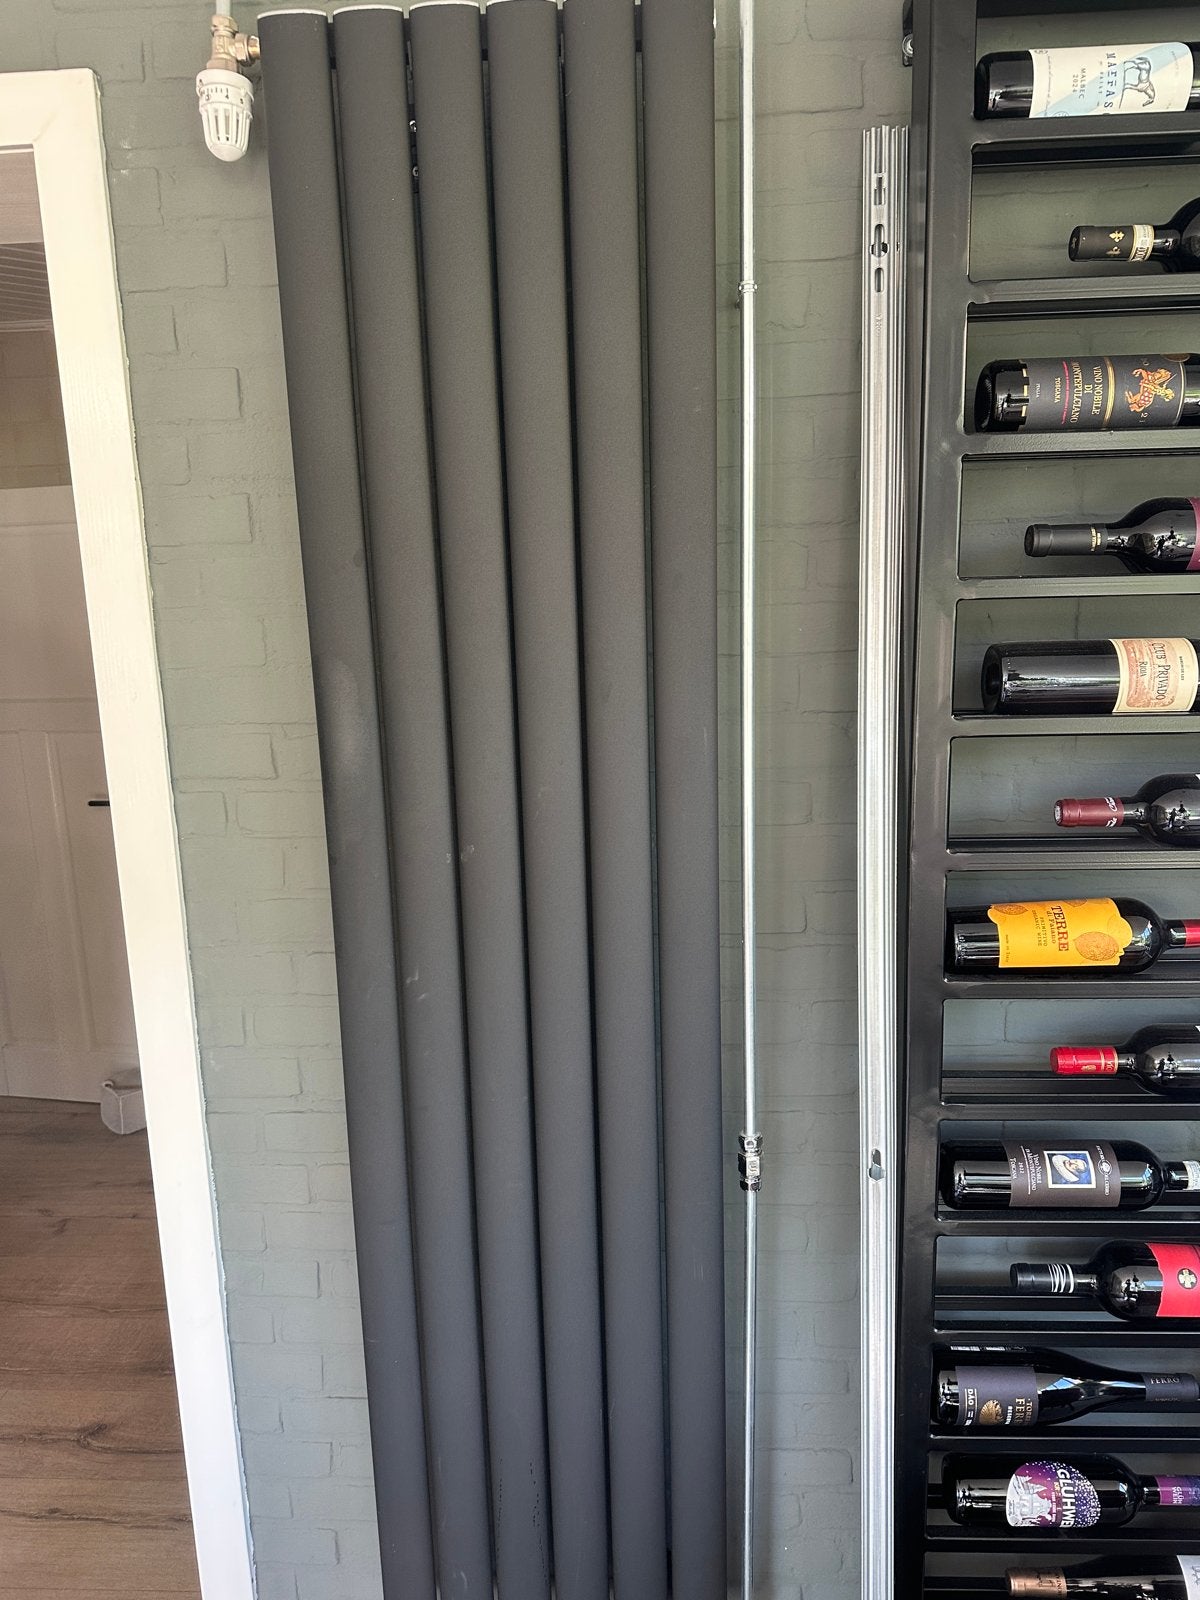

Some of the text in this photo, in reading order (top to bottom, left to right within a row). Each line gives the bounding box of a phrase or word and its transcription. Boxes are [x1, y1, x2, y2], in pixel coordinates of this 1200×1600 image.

[1085, 384, 1092, 393] DI
[1091, 366, 1102, 415] VINO NOBILE
[1139, 661, 1148, 677] RIOJA
[1152, 643, 1170, 700] CLUB PRIVADO
[1039, 917, 1047, 947] PRIMITIVO
[1050, 906, 1069, 952] TERRE
